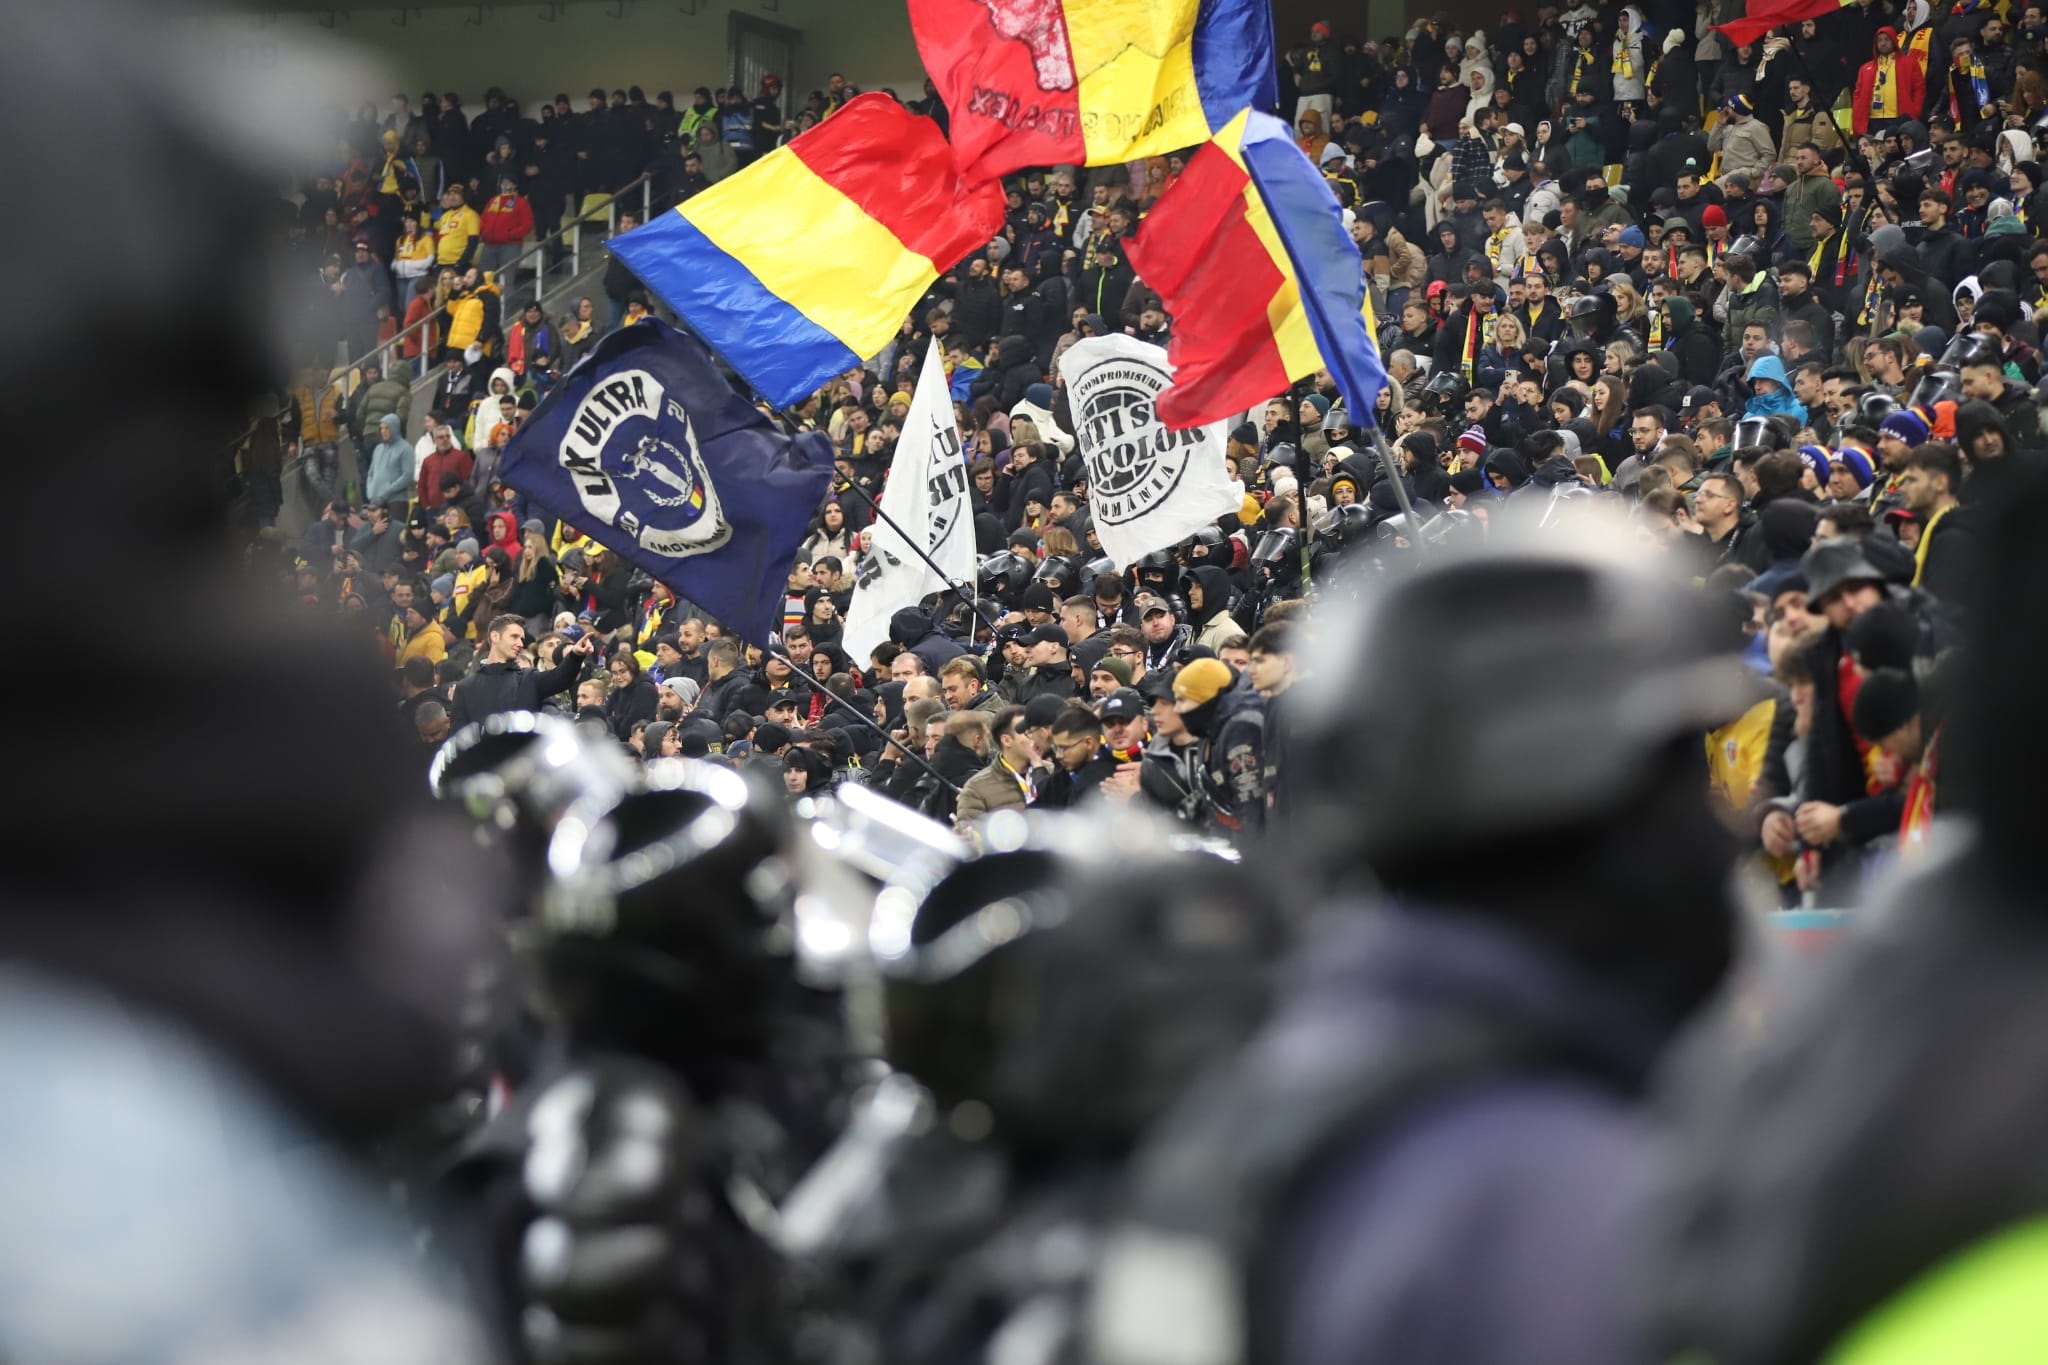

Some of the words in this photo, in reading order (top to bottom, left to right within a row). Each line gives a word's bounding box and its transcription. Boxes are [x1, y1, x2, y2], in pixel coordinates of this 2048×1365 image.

[1080, 370, 1163, 395] COMPROMISURI
[574, 376, 649, 447] ULTRA
[565, 446, 613, 495] LX
[1091, 426, 1206, 485] ICOLOR
[1096, 465, 1175, 517] OMÂNIA
